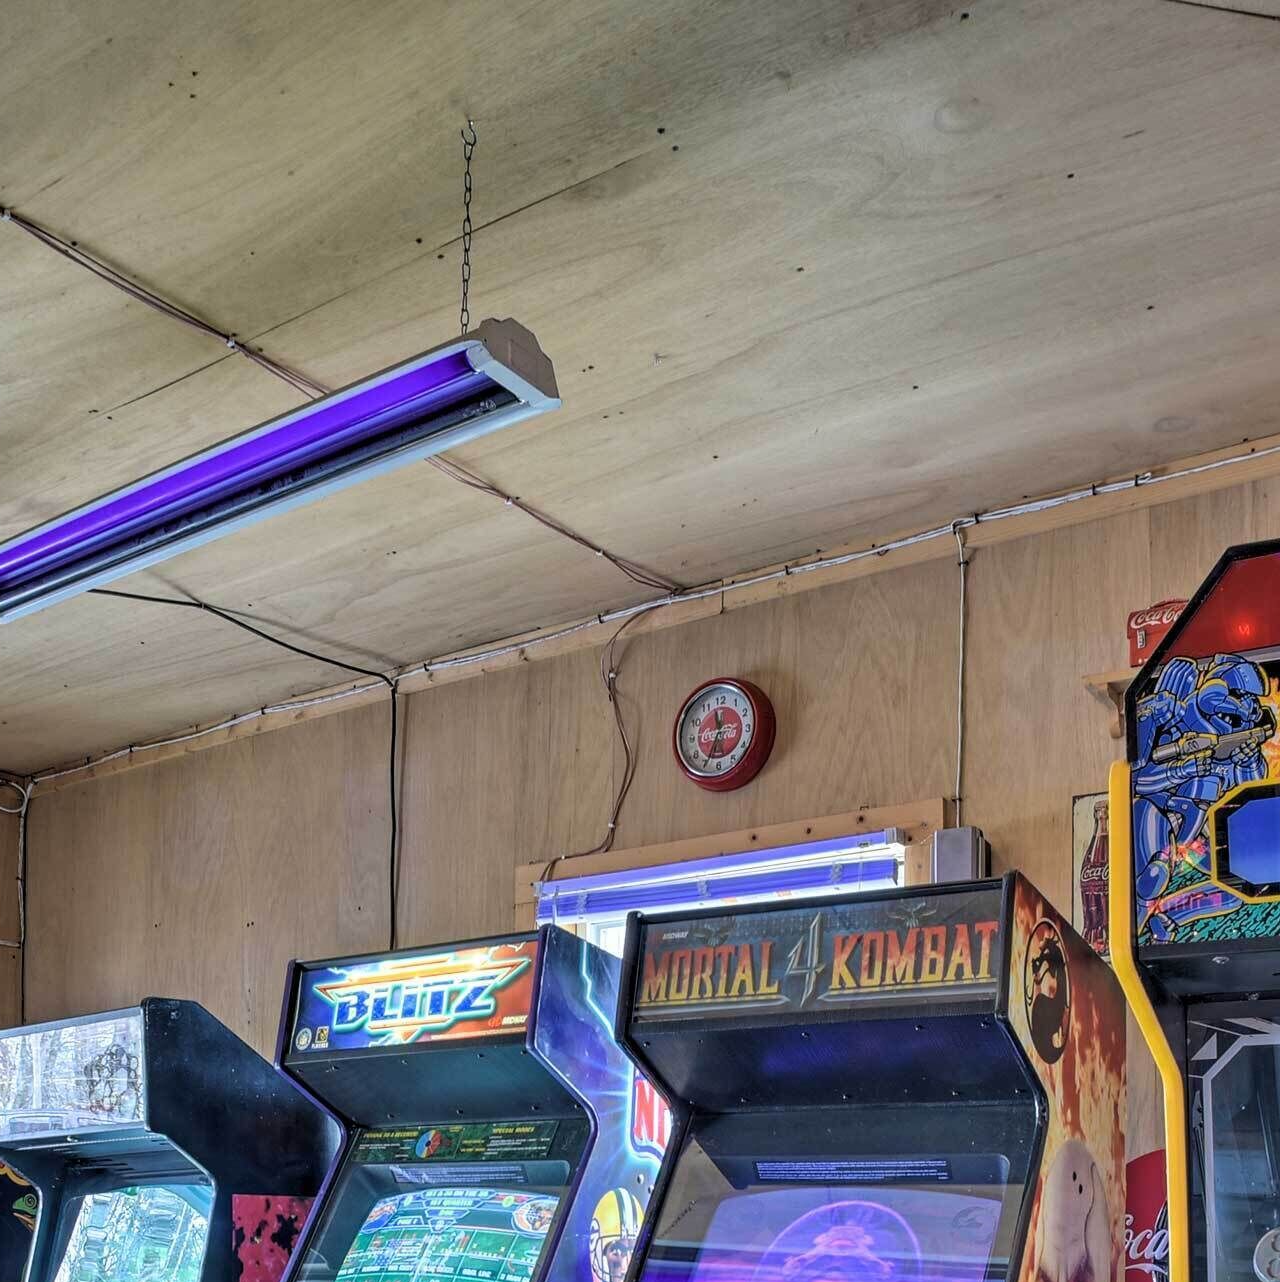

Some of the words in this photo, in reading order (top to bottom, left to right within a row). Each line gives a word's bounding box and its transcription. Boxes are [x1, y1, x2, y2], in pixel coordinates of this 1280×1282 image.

[716, 696, 726, 705] 12
[641, 941, 780, 1003] MORTAL
[786, 912, 824, 1008] 4
[831, 921, 999, 990] KOMBAT
[335, 976, 496, 1027] BLITZ
